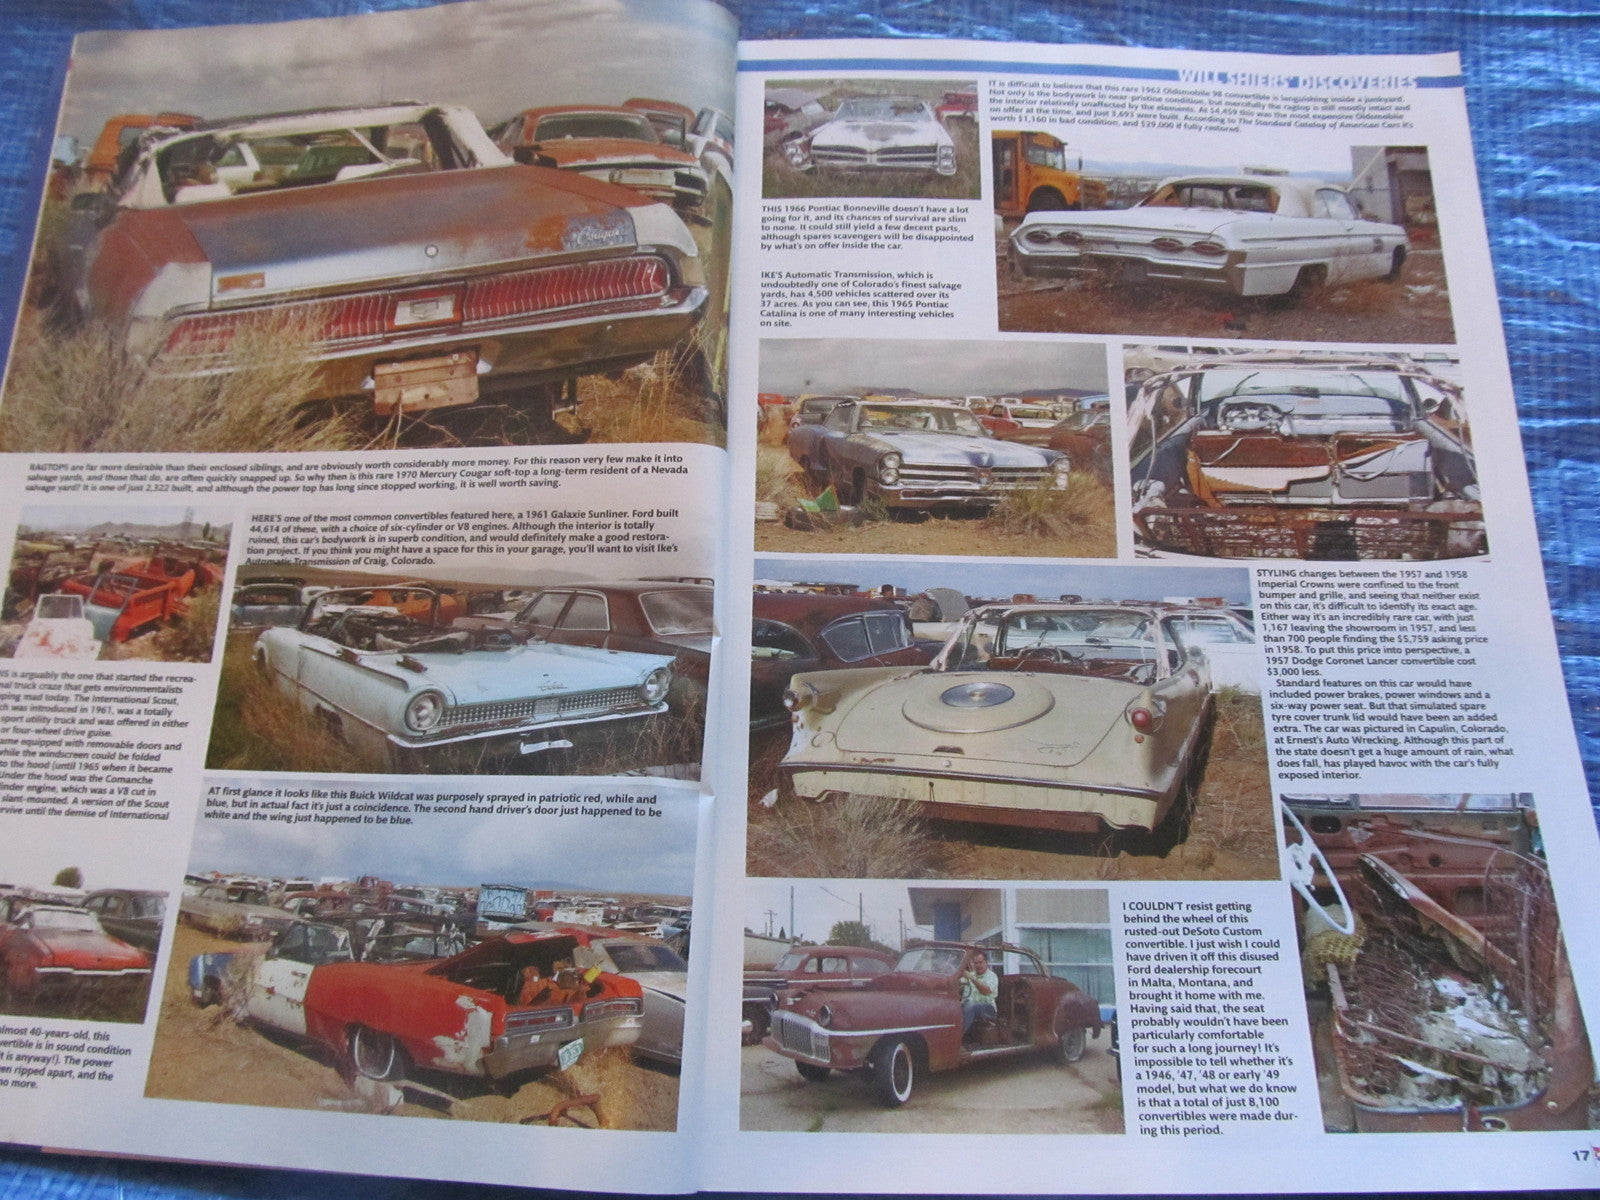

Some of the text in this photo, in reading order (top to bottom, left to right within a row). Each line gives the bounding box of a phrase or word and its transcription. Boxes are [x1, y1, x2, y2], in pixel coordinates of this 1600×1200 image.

[1178, 69, 1418, 89] WILL SHIERS' DISCOVERIES
[1006, 80, 1040, 88] difficult
[1052, 82, 1084, 90] believe
[1162, 87, 1210, 96] Oldsmobile
[1223, 90, 1270, 100] convertible
[762, 204, 782, 212] THIS
[784, 204, 806, 212] 1966
[842, 204, 890, 212] Bonneville
[891, 204, 924, 212] doesn't
[925, 205, 947, 213] have
[956, 205, 968, 213] lot
[761, 232, 974, 243] although spares scavengers will be disappointed
[761, 270, 933, 280] IKE'S Automatic Transmission, which is
[760, 309, 797, 317] Catalina
[799, 309, 806, 317] is
[827, 309, 838, 317] of
[839, 310, 865, 319] many
[867, 308, 916, 320] interesting
[917, 309, 954, 318] vehicles
[285, 462, 303, 470] and
[320, 461, 363, 472] obviously
[364, 460, 391, 468] worth
[392, 459, 449, 470] considerably
[477, 459, 511, 468] money.
[512, 457, 529, 465] For
[529, 457, 547, 465] this
[582, 457, 604, 466] very
[605, 455, 624, 463] few
[625, 455, 652, 463] make
[663, 454, 682, 462] into
[252, 514, 282, 522] HERE'S
[313, 513, 328, 521] the
[329, 513, 351, 521] most
[393, 512, 448, 521] convertibles
[450, 512, 489, 520] featured
[491, 512, 515, 521] here,
[526, 511, 547, 519] 1961
[550, 511, 586, 519] Galaxie
[587, 510, 629, 518] Sunliner.
[631, 510, 654, 518] Ford
[655, 510, 678, 518] built
[1256, 569, 1467, 579] STYLING changes between the 1957 and 1958
[1266, 656, 1476, 667] 1957 Dodge Coronet Lancer convertible cost
[1267, 667, 1322, 676] $3,000 less.
[1, 714, 24, 724] sport
[25, 714, 52, 725] utility
[53, 715, 76, 723] truck
[77, 716, 96, 724] and
[116, 717, 150, 726] offered
[150, 718, 160, 726] in
[161, 719, 188, 727] either
[1278, 770, 1362, 781] exposed interior.
[80, 797, 114, 806] version
[114, 798, 126, 806] of
[126, 799, 142, 807] the
[143, 799, 169, 808] Scout
[205, 811, 413, 825] white and the wing just happened to be blue.
[1128, 902, 1183, 910] COULDN'T
[1185, 902, 1213, 910] resist
[1215, 902, 1251, 913] getting
[1124, 927, 1262, 936] rusted-out DeSoto Custom
[1128, 978, 1253, 988] in Malta, Montana, and
[29, 1027, 90, 1042] 40-years-old,
[92, 1031, 109, 1041] this
[1132, 1030, 1263, 1042] particularly comfortable
[1139, 1112, 1206, 1120] convertibles
[1239, 1112, 1271, 1120] made
[1273, 1112, 1298, 1120] dur-
[1140, 1126, 1224, 1137] ing this period.
[1573, 1150, 1590, 1161] 17
